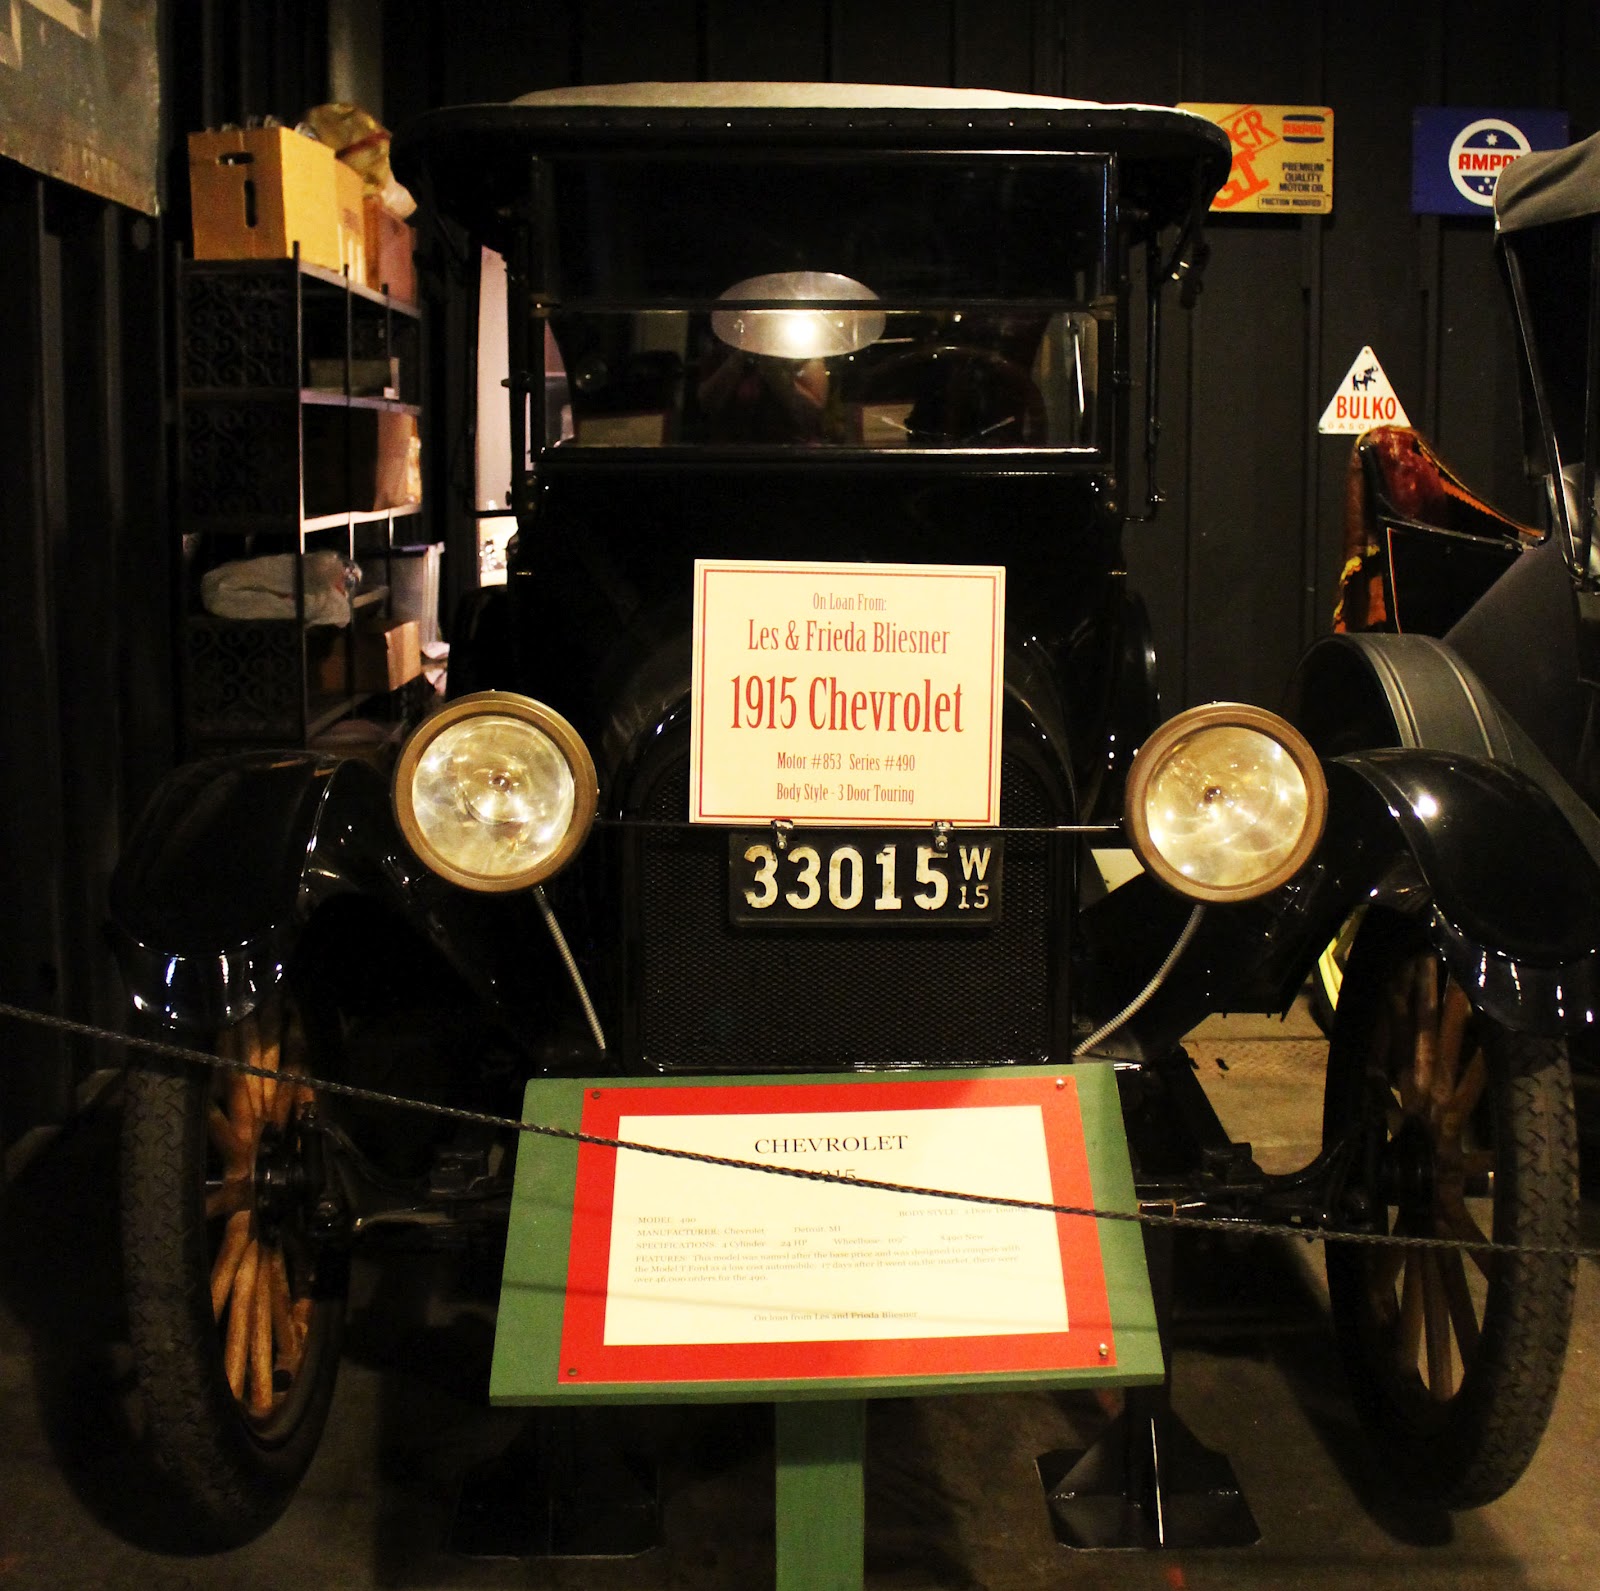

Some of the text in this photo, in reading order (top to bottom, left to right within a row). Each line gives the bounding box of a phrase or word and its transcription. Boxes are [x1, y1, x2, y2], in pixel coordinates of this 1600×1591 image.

[1223, 110, 1277, 149] ER
[1282, 162, 1324, 172] PREMIUM
[1458, 153, 1522, 171] AMPO
[1285, 172, 1320, 182] QUALITY
[1279, 183, 1310, 192] MOTOR
[1336, 396, 1397, 420] BULKO
[812, 592, 887, 612] On Loan From:
[748, 618, 951, 655] Les & Frieda Bliesner
[730, 674, 965, 733] 1915 Chevrolet
[777, 751, 916, 772] Motor #853 Series #490
[776, 782, 801, 803] Body
[803, 783, 829, 803] Style
[838, 783, 845, 801] 3
[847, 783, 871, 802] Door
[873, 784, 915, 805] Touring
[959, 846, 992, 881] W
[744, 844, 949, 911] 33015
[958, 884, 990, 910] 15
[754, 1135, 909, 1154] CHEVROLET
[809, 1168, 857, 1184] 915
[724, 1226, 765, 1236] Chevrolet
[729, 1239, 766, 1249] Cylinder
[794, 1238, 808, 1247] HP
[694, 1253, 711, 1262] This
[713, 1253, 740, 1262] model
[760, 1253, 789, 1261] named
[791, 1252, 811, 1260] after
[814, 1251, 828, 1259] the
[829, 1250, 849, 1259] base
[850, 1250, 873, 1261] price
[875, 1249, 891, 1258] and
[911, 1247, 950, 1258] designed
[634, 1264, 649, 1274] the
[651, 1263, 678, 1273] Model
[689, 1263, 709, 1272] Ford
[729, 1262, 744, 1272] low
[832, 1260, 853, 1271] days
[854, 1258, 875, 1269] after
[886, 1258, 907, 1268] went
[634, 1275, 653, 1283] over
[688, 1273, 716, 1283] orders
[718, 1273, 731, 1282] for
[733, 1272, 748, 1281] the
[753, 1313, 767, 1322] On
[769, 1312, 788, 1321] loan
[790, 1312, 812, 1321] from
[815, 1312, 830, 1320] Les
[832, 1311, 848, 1320] and
[850, 1310, 880, 1319] Frieda
